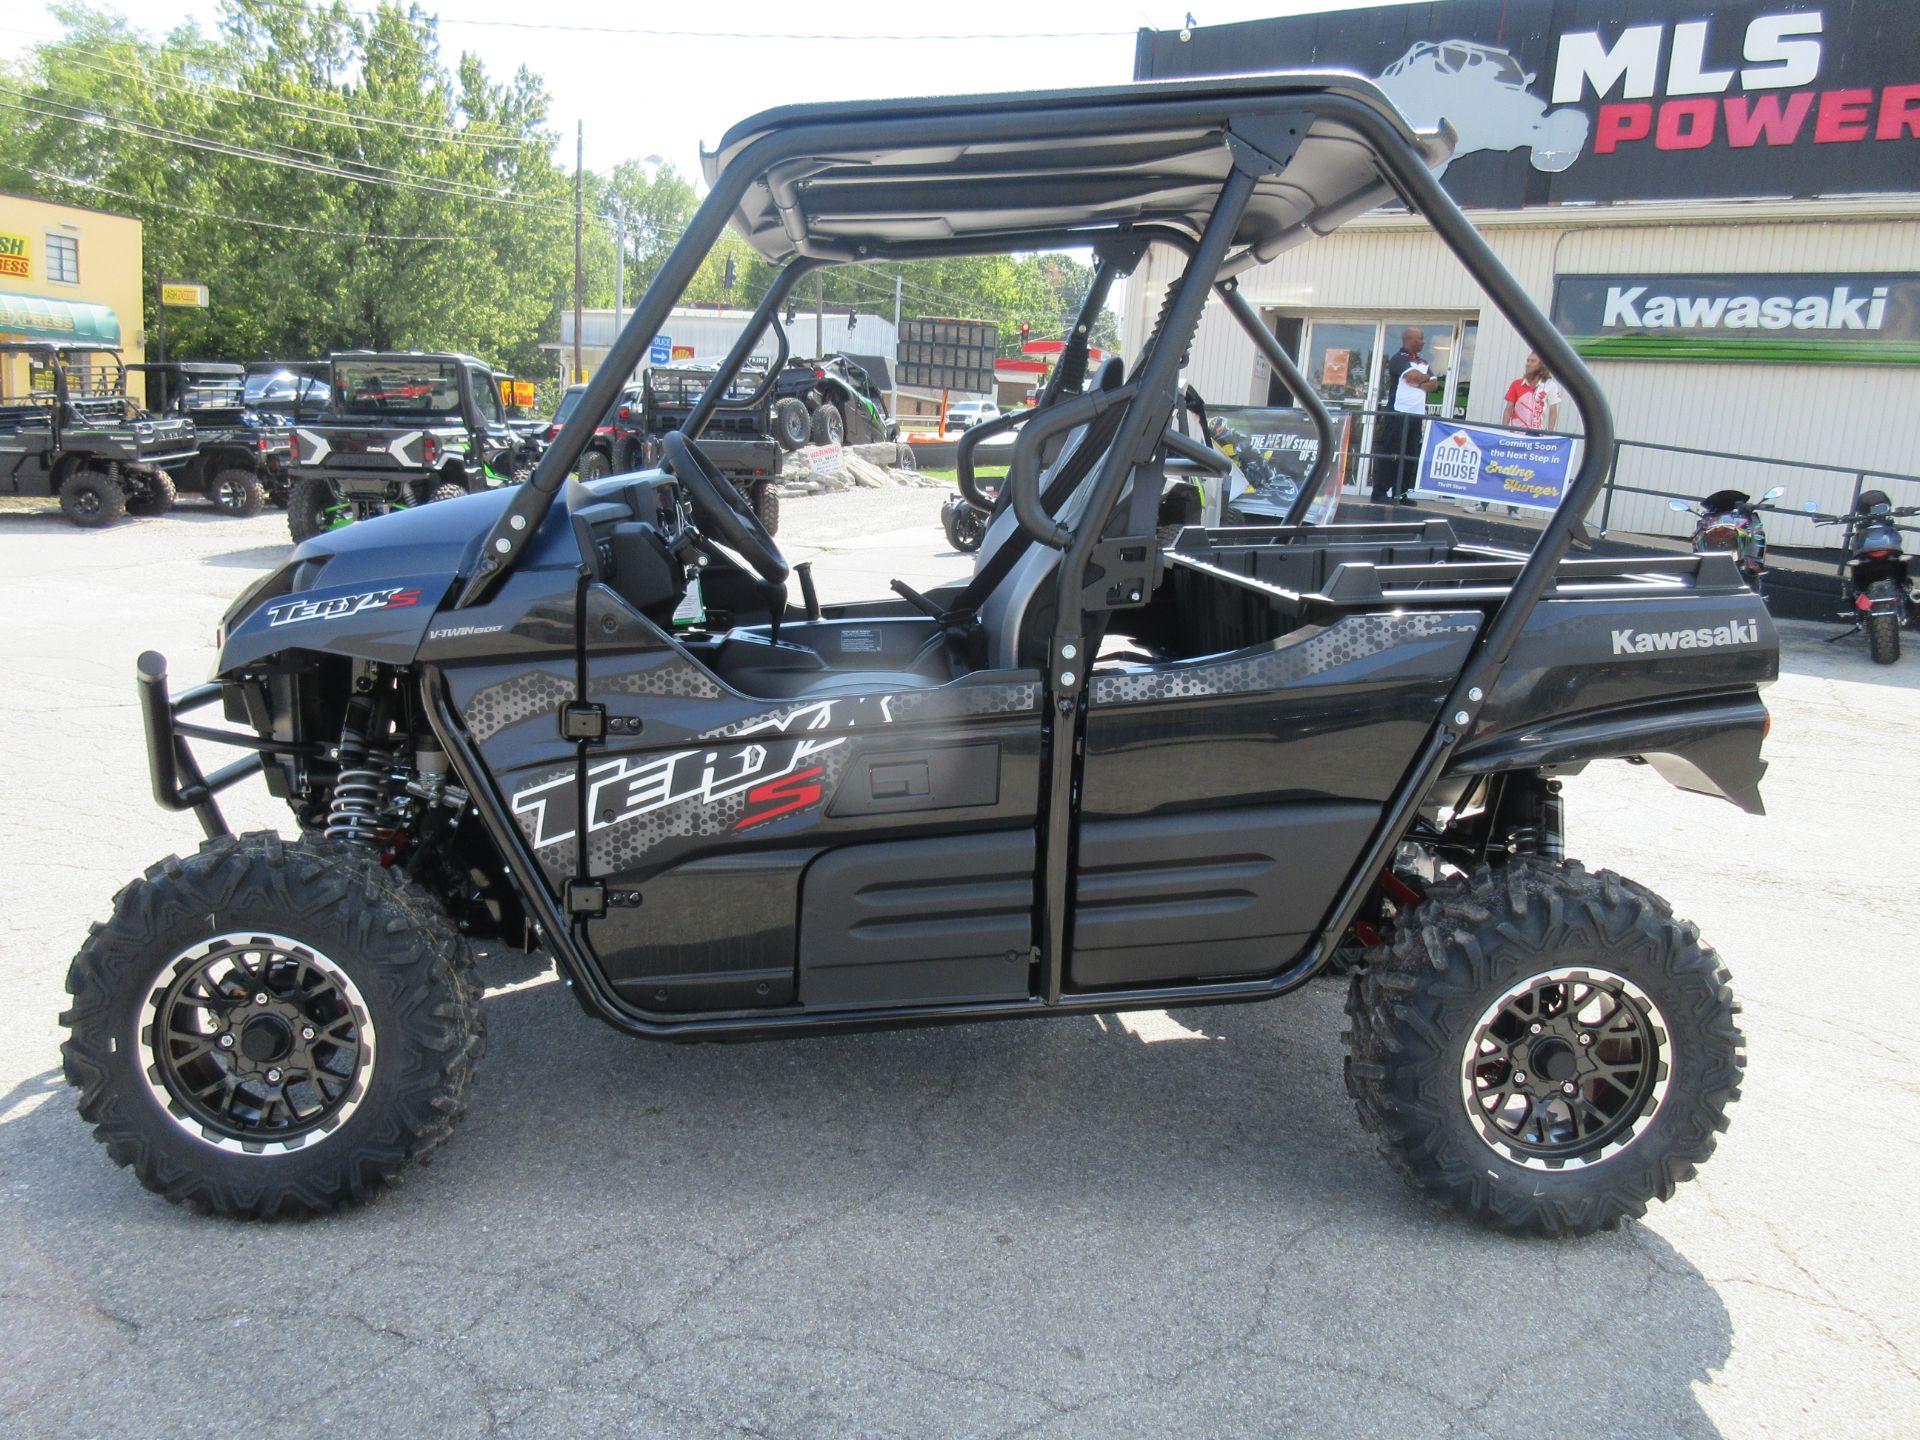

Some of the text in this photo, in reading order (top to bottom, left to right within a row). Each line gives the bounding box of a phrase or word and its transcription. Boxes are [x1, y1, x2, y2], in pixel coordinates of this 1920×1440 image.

[1552, 12, 1823, 104] MLS
[1594, 84, 1920, 154] POWER
[1602, 287, 1889, 330] Kawasaki
[1250, 436, 1265, 448] THE
[1265, 433, 1297, 449] NEW
[1498, 439, 1557, 452] Coming Soon
[810, 445, 840, 459] WARNING
[1436, 446, 1478, 465] AMEN
[1490, 449, 1560, 464] the Next Step in
[1433, 461, 1476, 480] HOUSE
[1485, 459, 1535, 481] Ending
[1503, 477, 1559, 498] Hunger
[1611, 618, 1758, 655] Kawasaki
